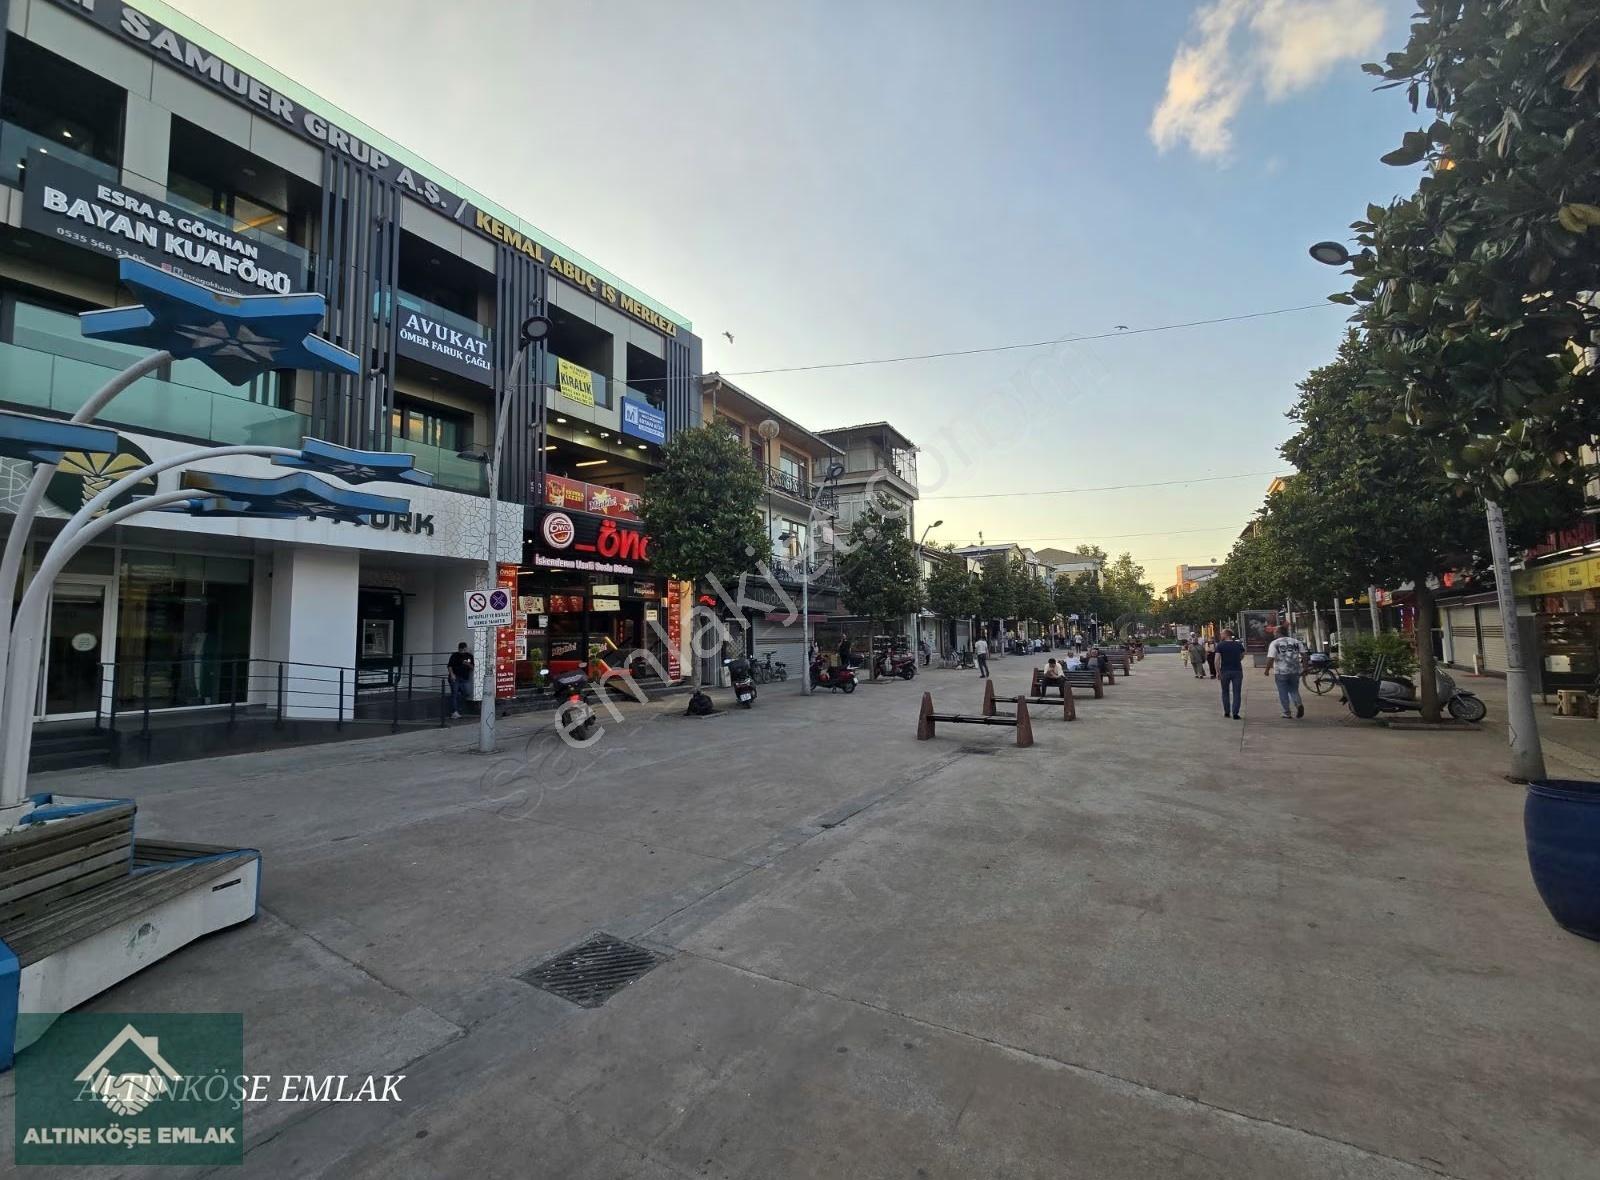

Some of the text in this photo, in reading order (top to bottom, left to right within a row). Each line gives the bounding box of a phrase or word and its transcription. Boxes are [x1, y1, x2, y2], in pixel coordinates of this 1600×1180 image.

[121, 7, 295, 123] SAMUER
[303, 112, 390, 170] GRUP
[476, 211, 545, 263] KEMAL
[43, 185, 292, 295] BAYAN KUAFÖRÜ
[56, 227, 88, 243] 0535
[90, 237, 113, 253] 566
[97, 184, 259, 260] ESRA & GÖKHAN
[399, 326, 491, 371] ÖMER FARUK ÇAĞLI
[405, 313, 488, 357] AVUKAT
